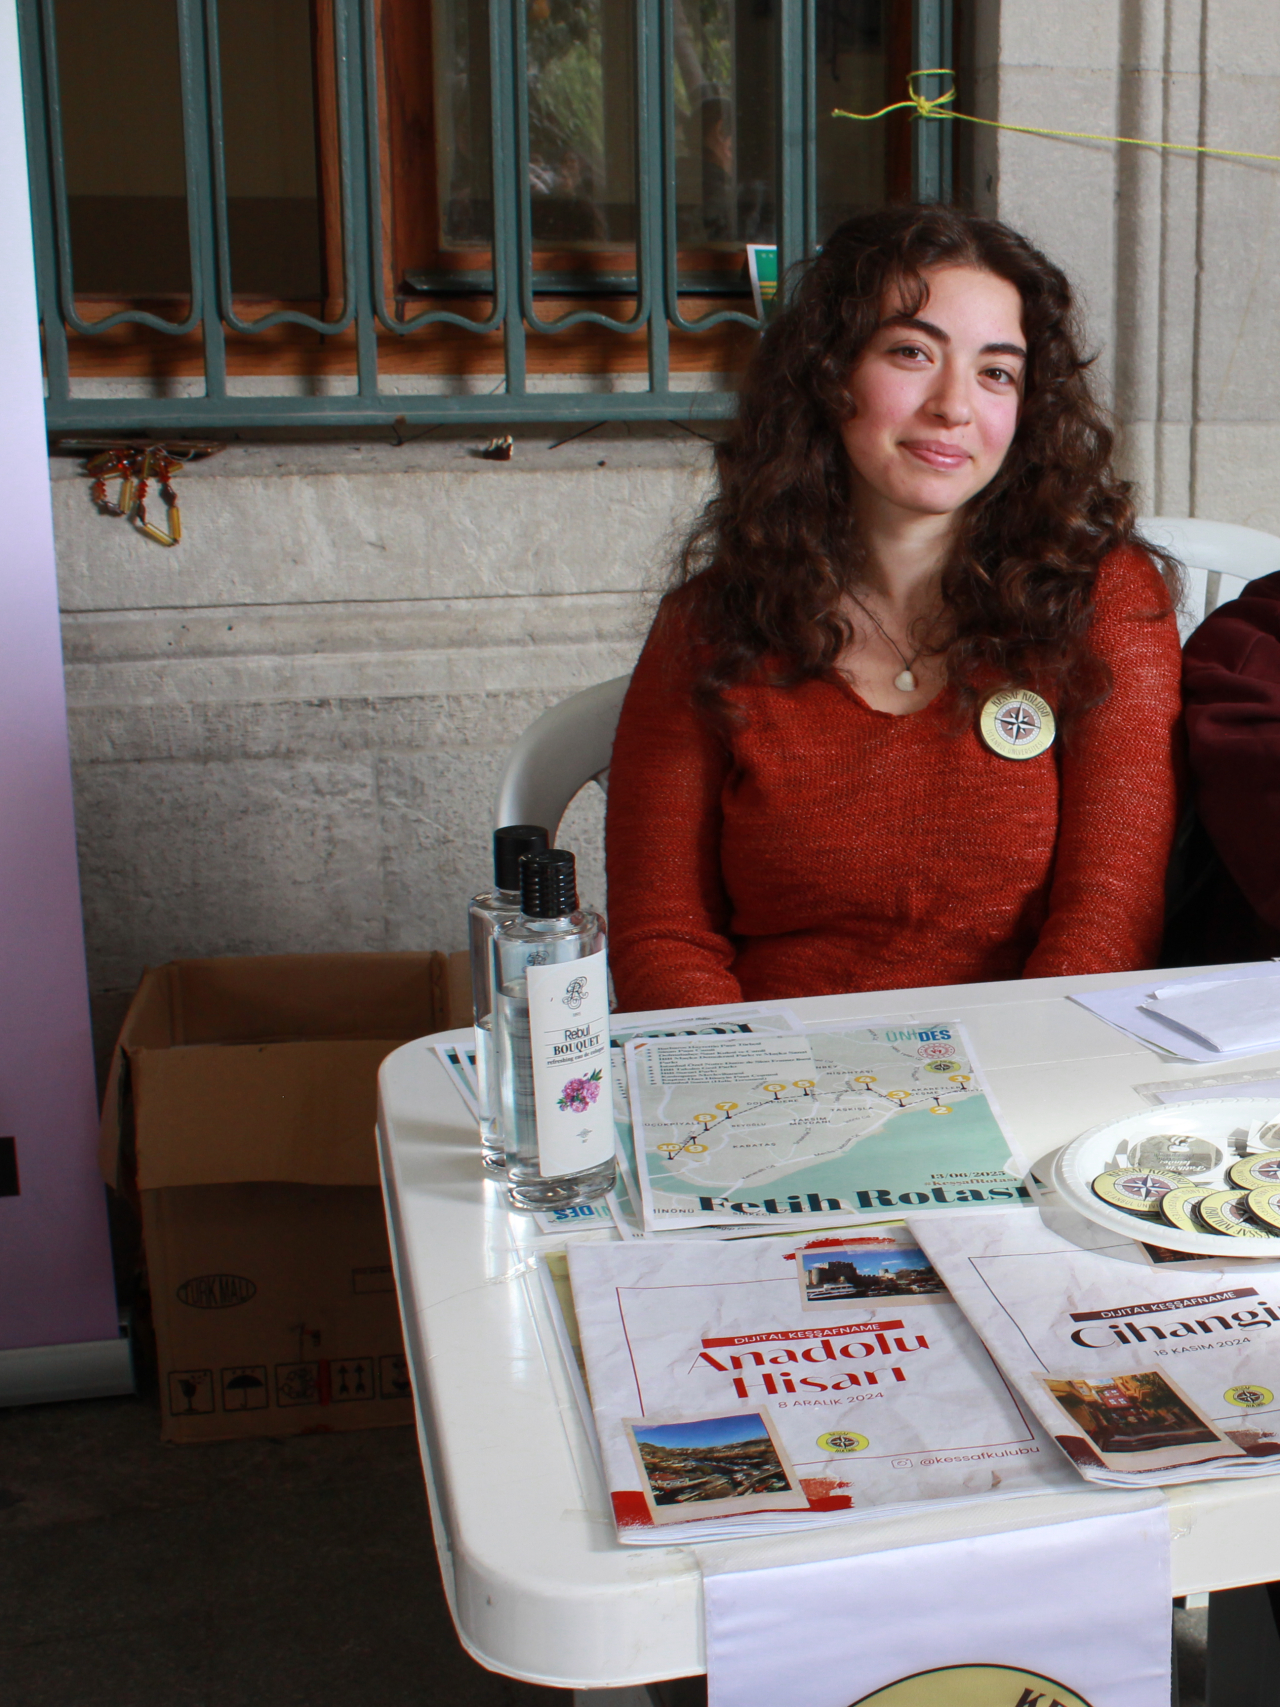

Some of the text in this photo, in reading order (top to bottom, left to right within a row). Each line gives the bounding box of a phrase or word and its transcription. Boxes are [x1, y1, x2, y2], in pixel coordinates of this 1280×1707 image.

[564, 1024, 591, 1042] Rebul
[553, 1034, 600, 1056] BOUQUET
[696, 1193, 844, 1214] Fetih
[687, 1333, 930, 1376] Anadolu
[1171, 1343, 1215, 1355] KASIM
[1217, 1336, 1252, 1349] 2024
[732, 1366, 907, 1399] Hisarı
[778, 1391, 885, 1409] 8 ARALIK 2024
[919, 1446, 1041, 1468] @kessafkulubu
